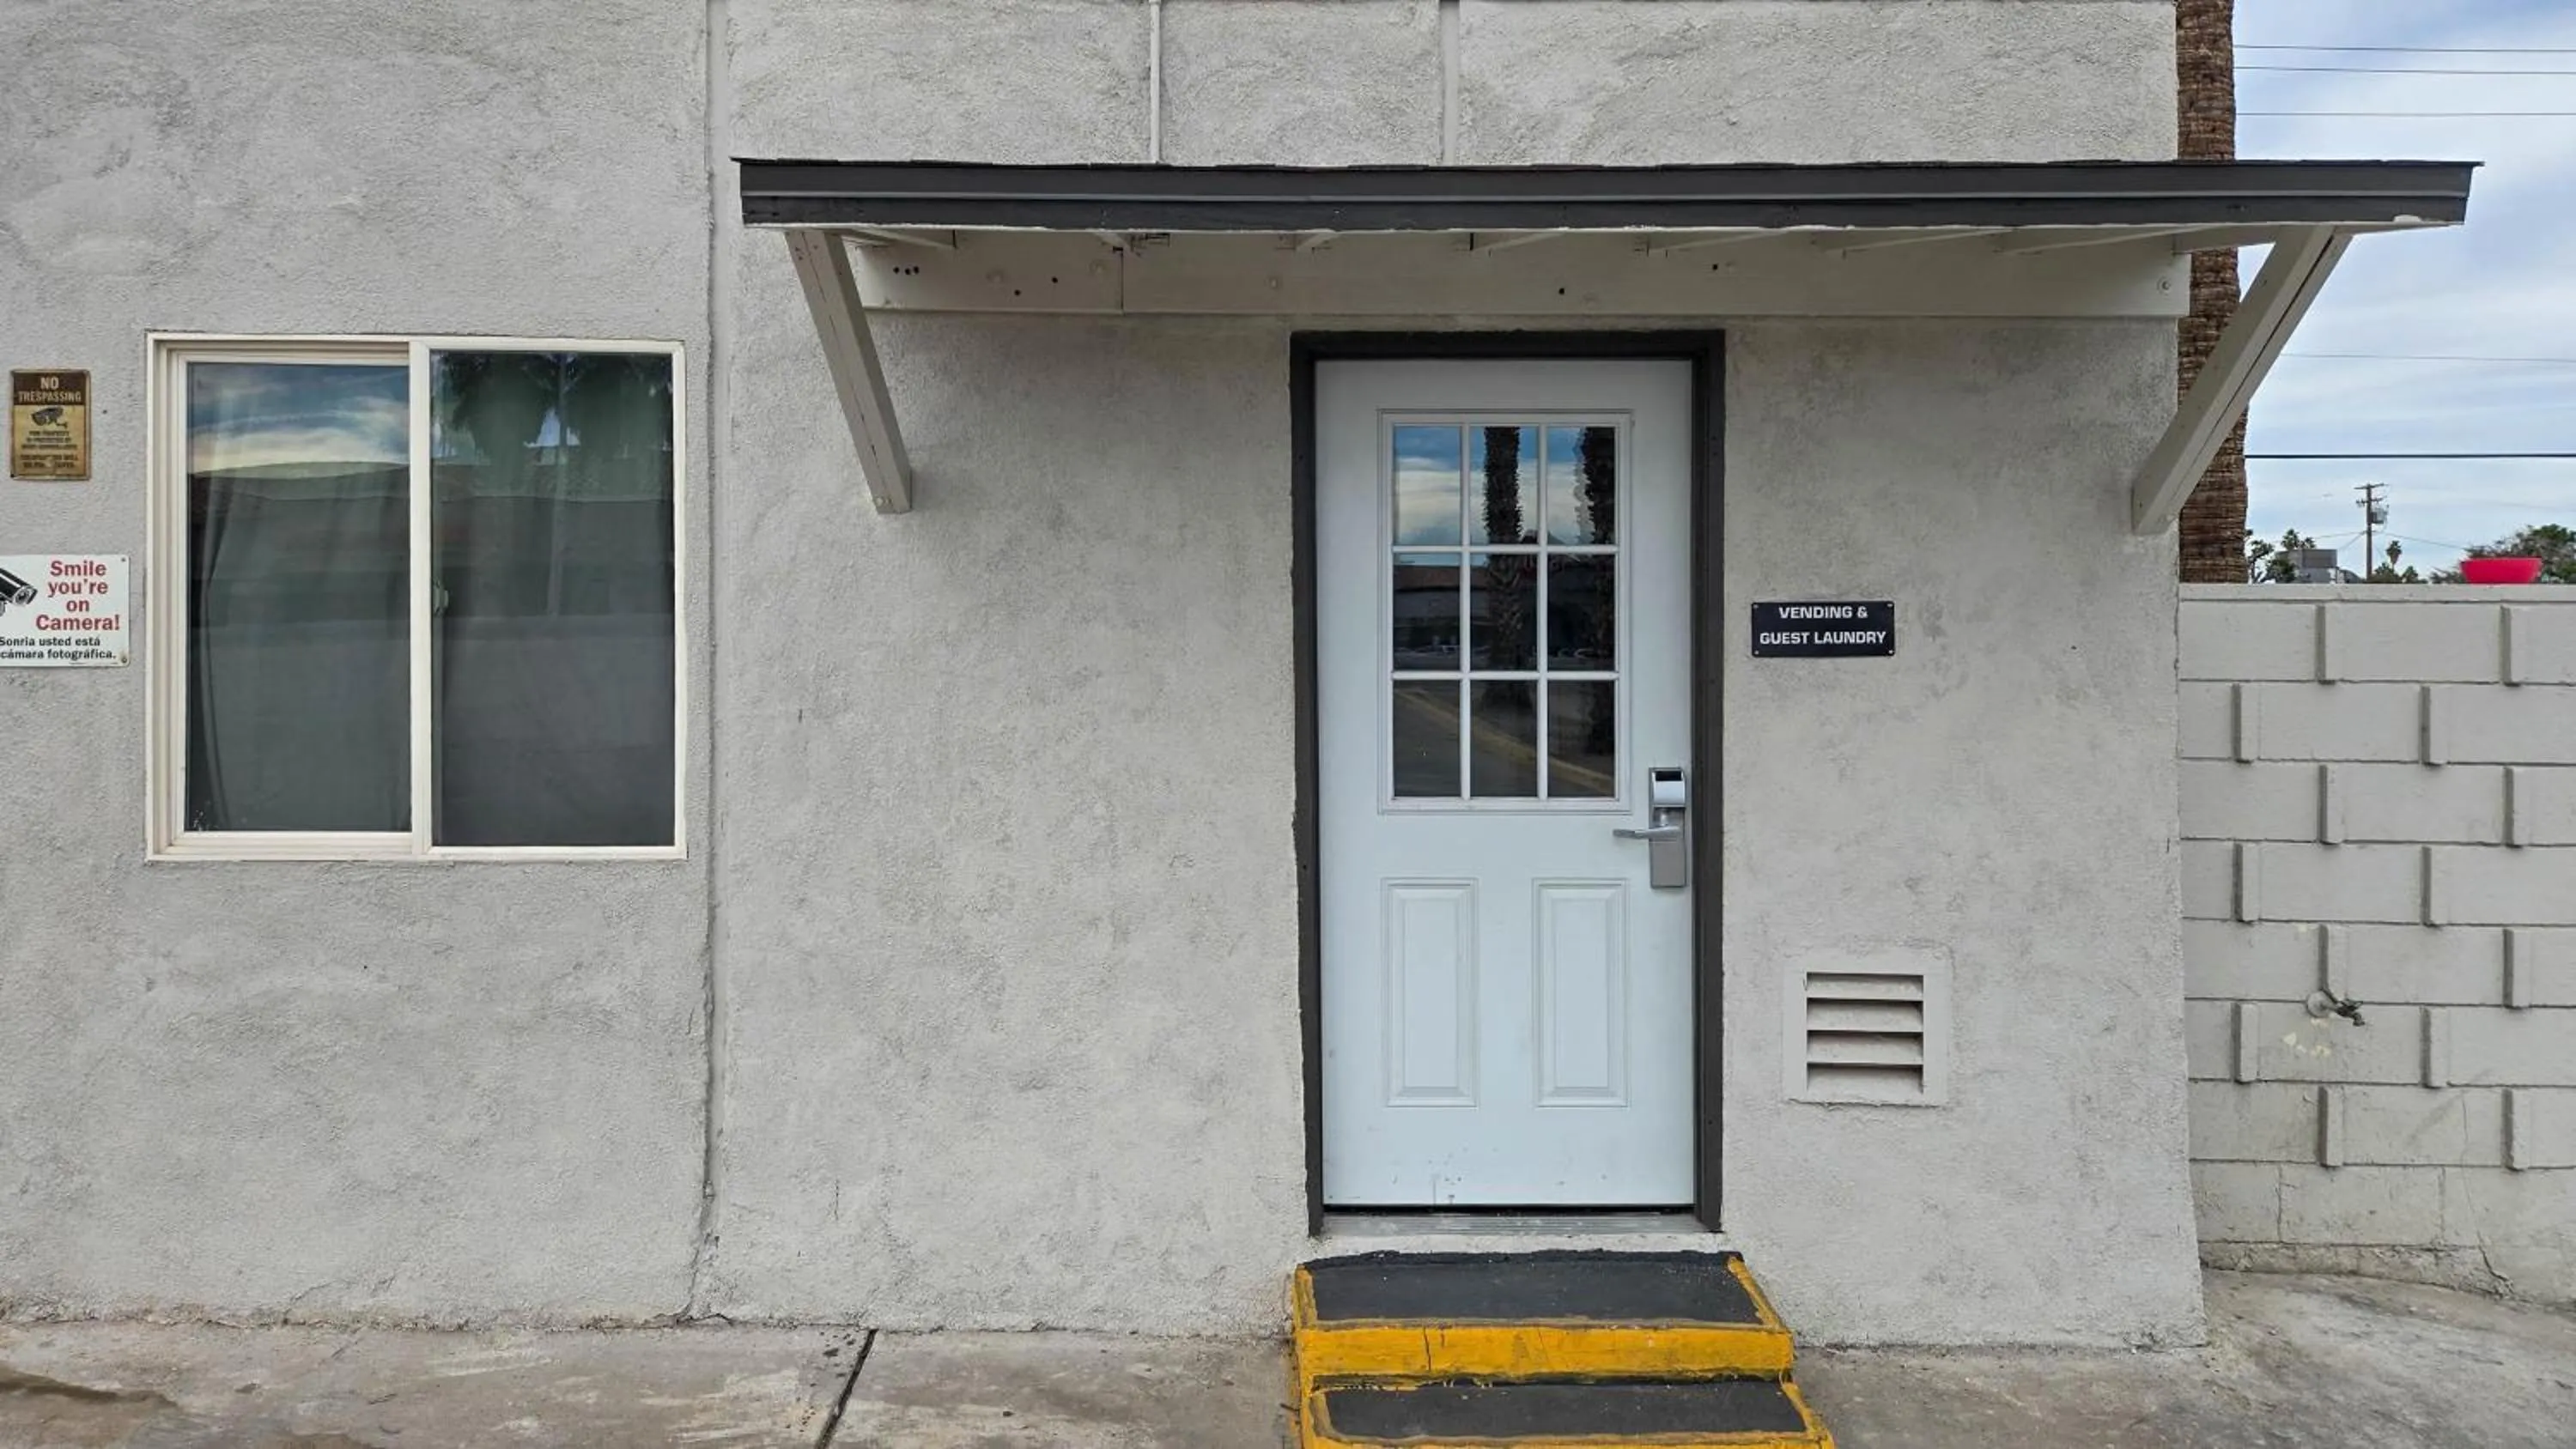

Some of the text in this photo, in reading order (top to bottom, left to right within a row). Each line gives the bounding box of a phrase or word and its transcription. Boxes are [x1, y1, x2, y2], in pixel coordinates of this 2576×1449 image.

[40, 376, 59, 390] NO
[18, 391, 82, 403] TRESPASSING
[50, 560, 106, 577] Smile
[47, 579, 108, 597] you're
[66, 600, 90, 612] on
[1778, 605, 1868, 619] VENDING &
[35, 614, 120, 631] Camera!
[39, 637, 71, 646] usted
[75, 635, 100, 646] está
[1759, 631, 1886, 645] GUEST LAUNDRY
[1, 648, 117, 662] cámara fotográfica.
